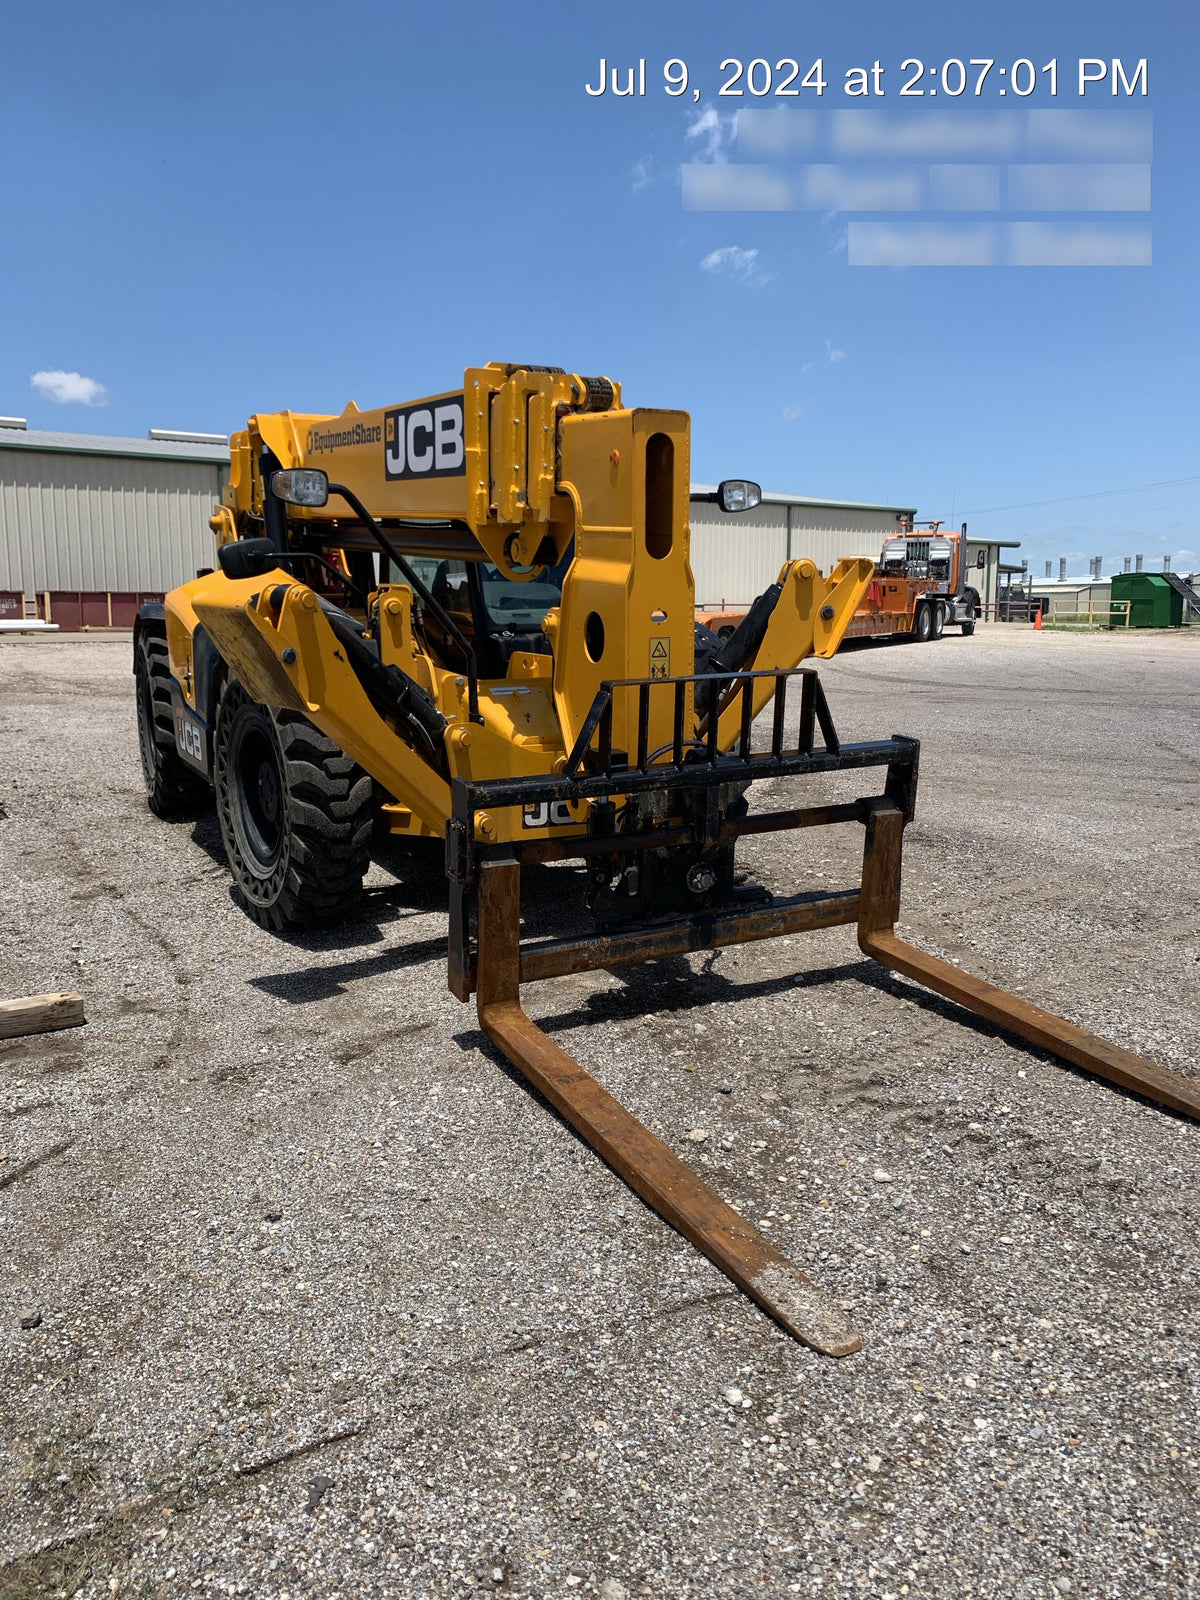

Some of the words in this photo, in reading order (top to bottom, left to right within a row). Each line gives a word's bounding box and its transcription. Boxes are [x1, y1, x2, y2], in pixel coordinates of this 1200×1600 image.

[313, 423, 382, 454] EquipmentShare
[386, 403, 464, 475] JCB
[180, 719, 202, 761] JCB
[524, 800, 576, 826] JC
